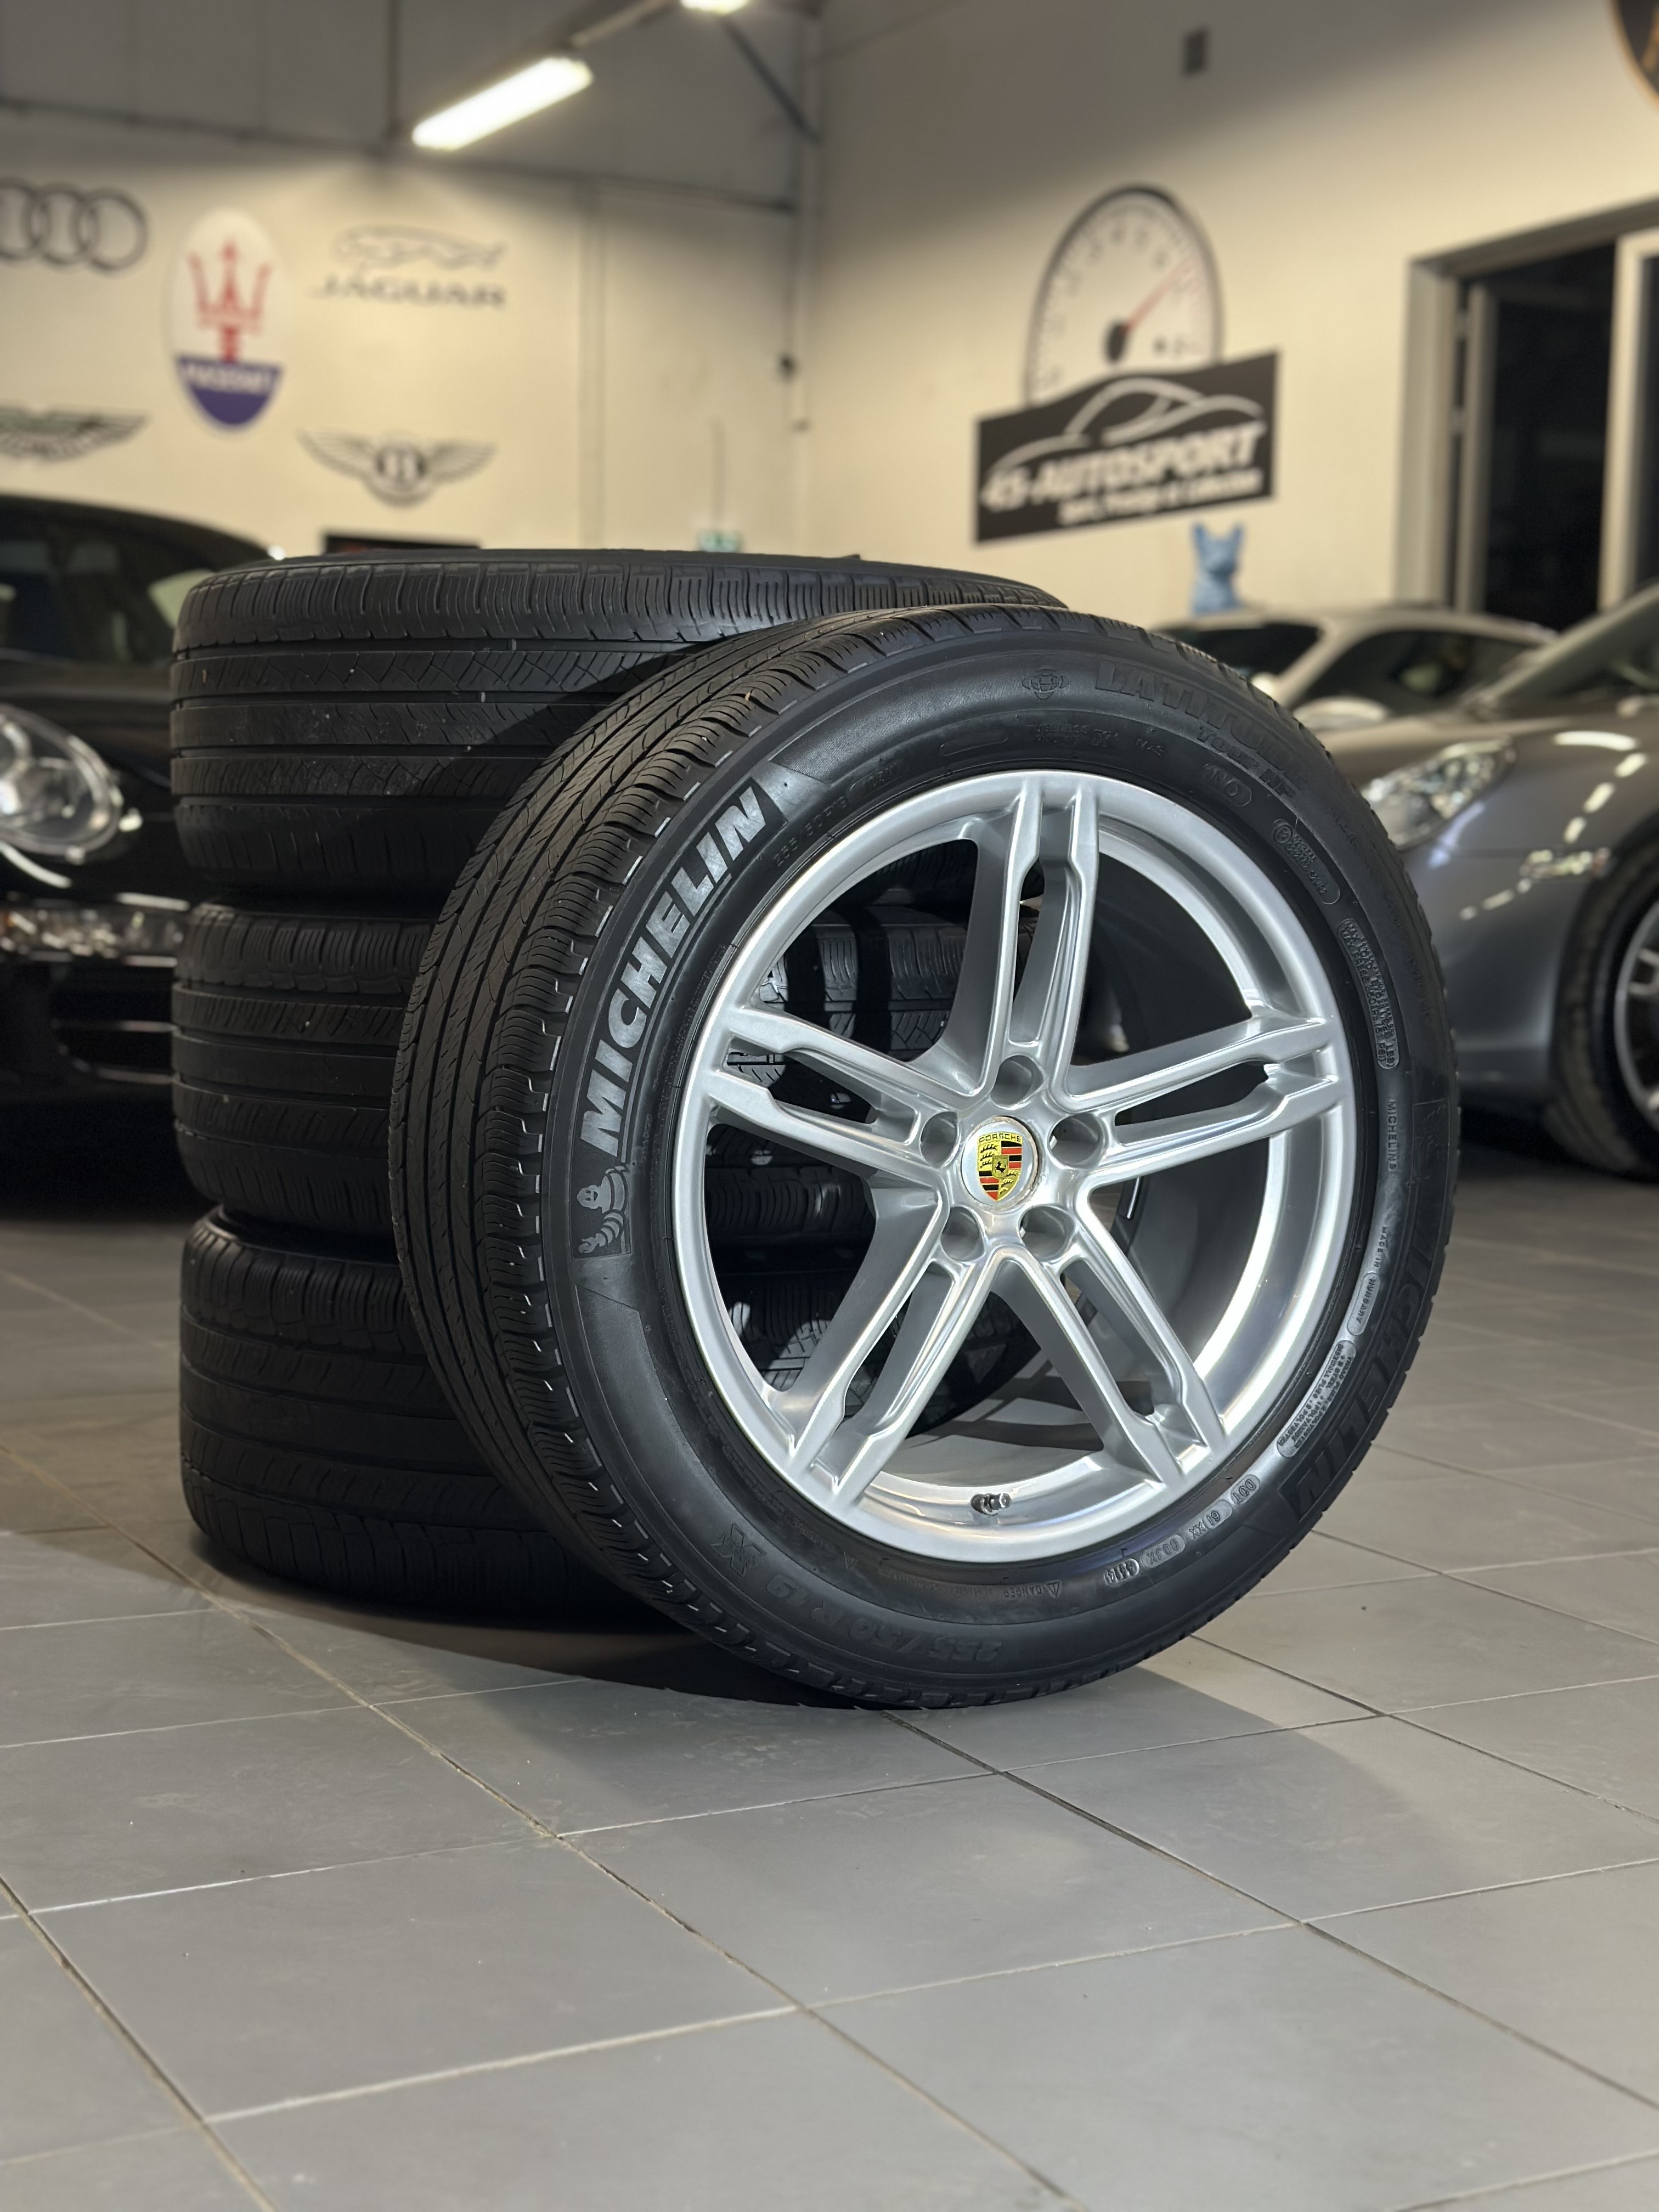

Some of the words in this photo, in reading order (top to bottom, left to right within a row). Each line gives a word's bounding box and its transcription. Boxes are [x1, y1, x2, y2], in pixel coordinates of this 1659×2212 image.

[580, 786, 767, 1156] MICHELIN
[979, 1133, 1022, 1143] PORSCHE
[1385, 1098, 1397, 1163] MICHELIN
[1376, 1225, 1389, 1252] MADE
[1373, 1256, 1382, 1268] IN
[1354, 1277, 1376, 1324] HUNGARY
[1232, 1476, 1257, 1504] DOT
[1002, 1583, 1042, 1597] DANGER
